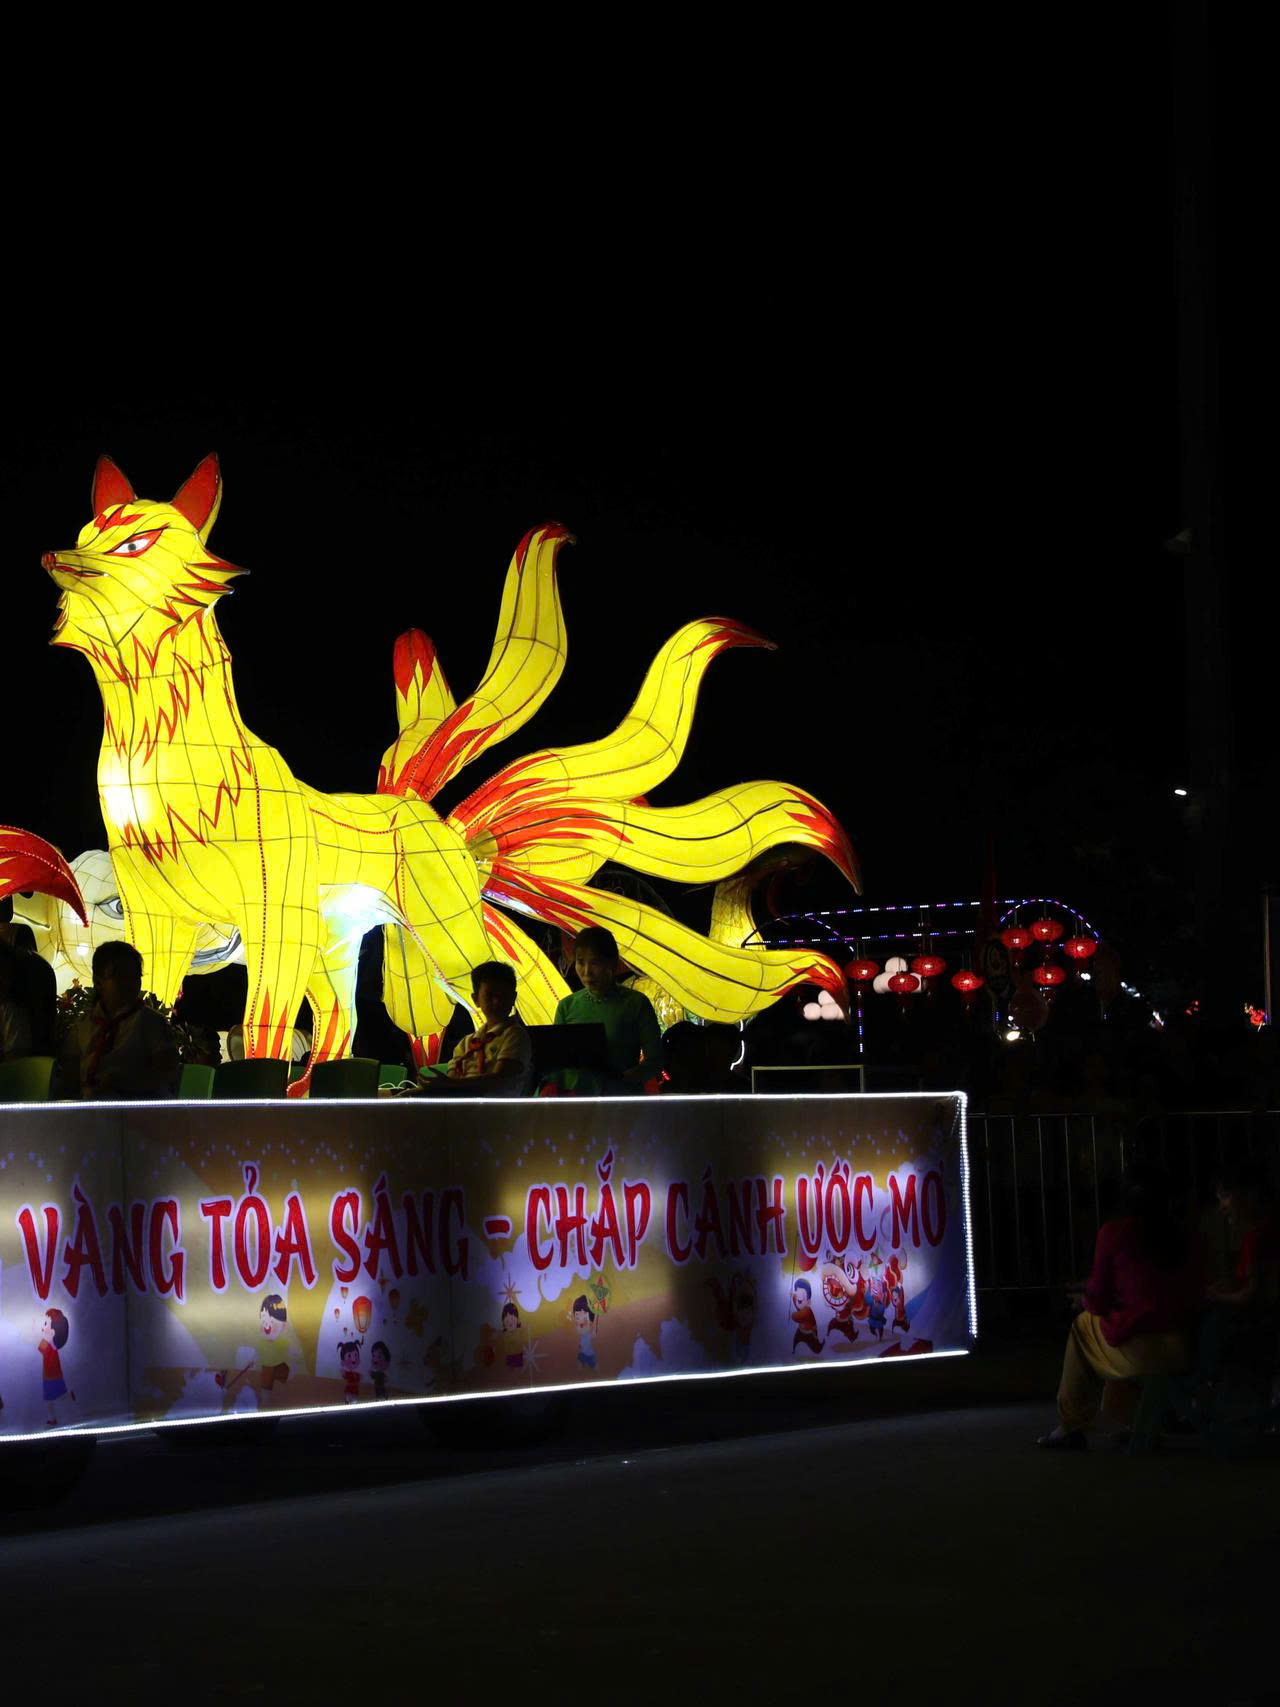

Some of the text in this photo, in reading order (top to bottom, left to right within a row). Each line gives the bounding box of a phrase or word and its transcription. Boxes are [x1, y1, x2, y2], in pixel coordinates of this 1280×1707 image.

[19, 1184, 183, 1300] VÀNG
[201, 1164, 316, 1290] TỎA
[331, 1175, 469, 1283] SÁNG
[527, 1149, 651, 1270] CHẮP
[666, 1165, 786, 1263] CÁNH
[798, 1160, 878, 1254] ƯỚC
[888, 1159, 947, 1249] MƠ
